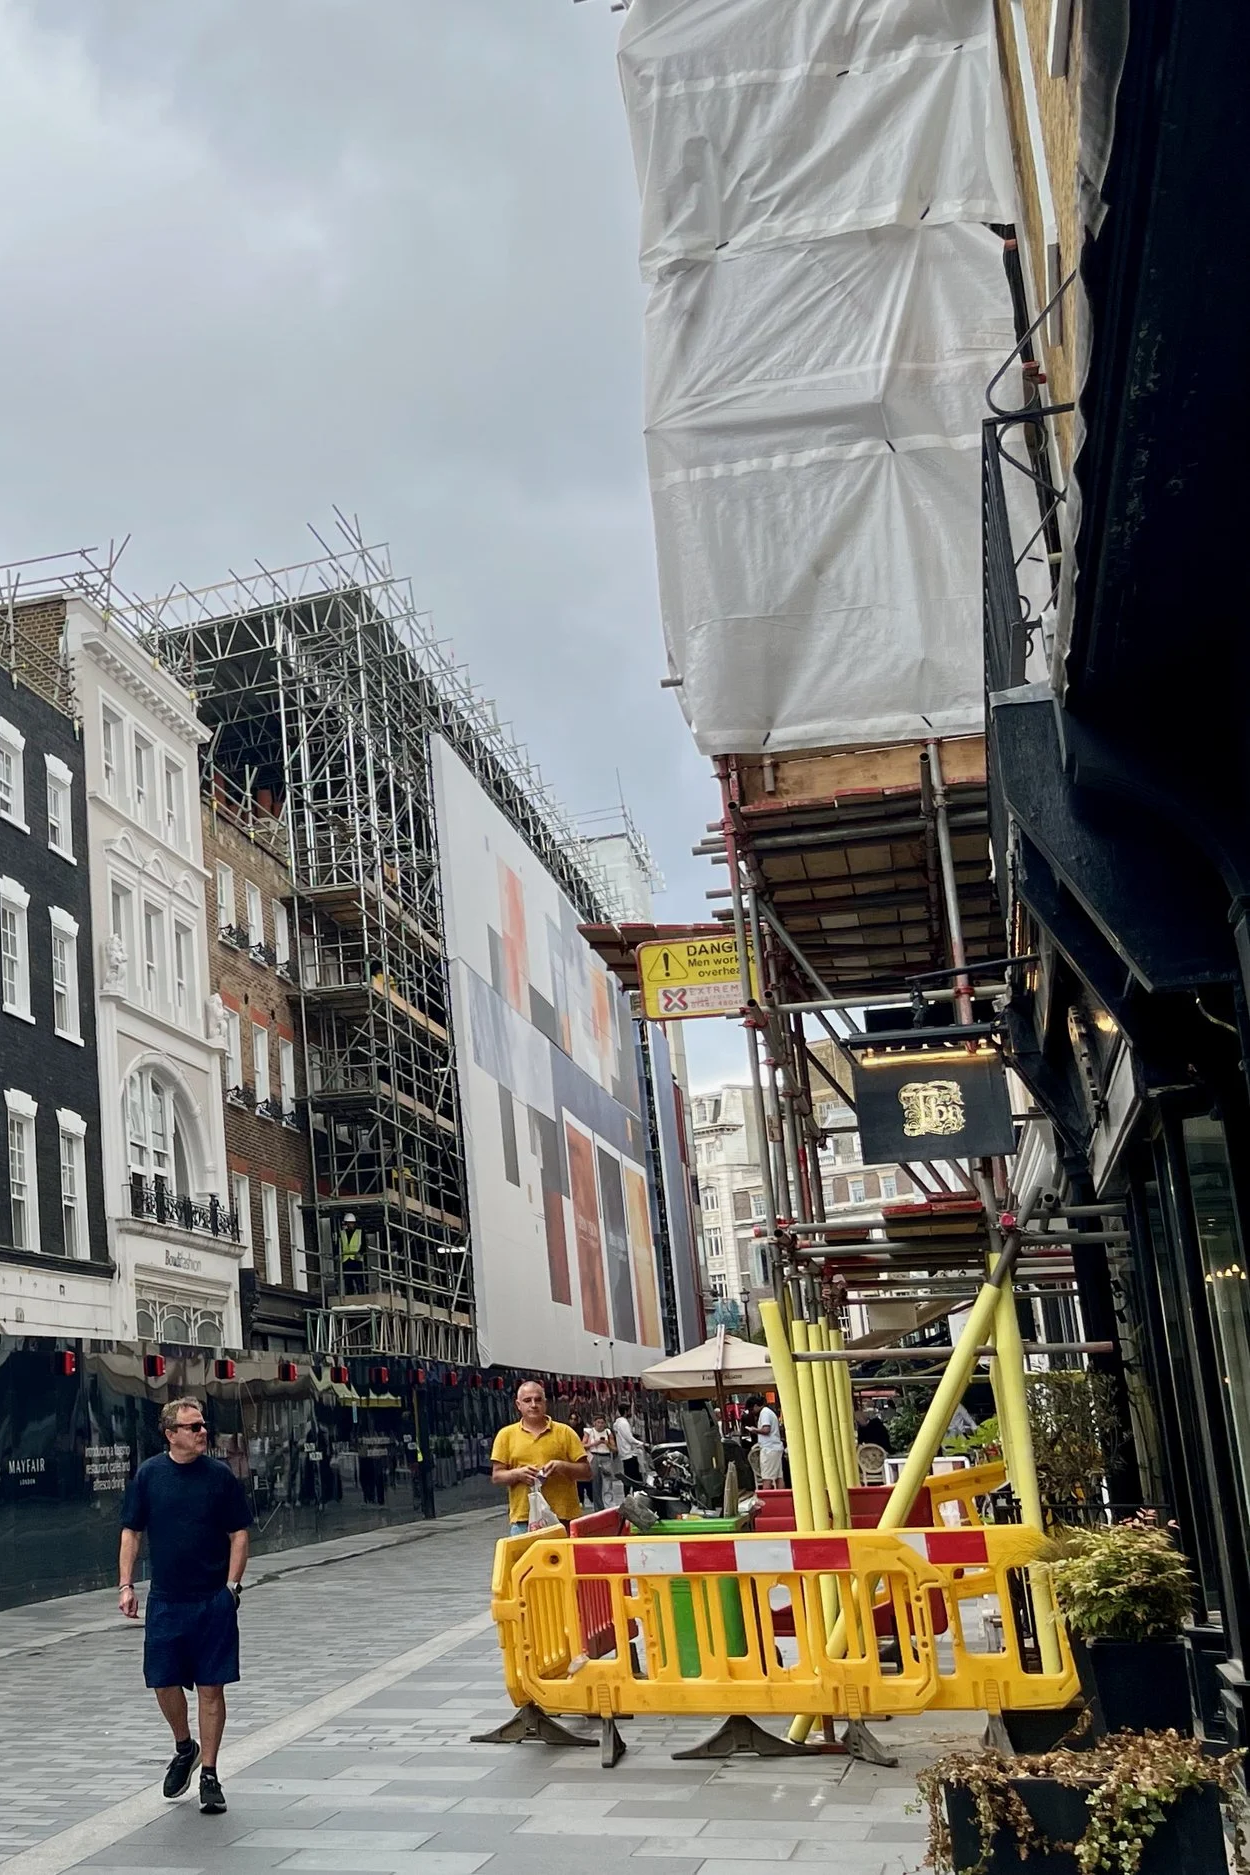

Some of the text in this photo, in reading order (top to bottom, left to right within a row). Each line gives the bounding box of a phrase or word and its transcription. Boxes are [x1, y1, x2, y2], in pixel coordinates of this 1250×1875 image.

[686, 941, 754, 956] DANGR
[688, 955, 756, 967] Men workg
[698, 966, 741, 977] overhea
[690, 984, 740, 996] EXTREM
[8, 1457, 45, 1475] MAYFAIR
